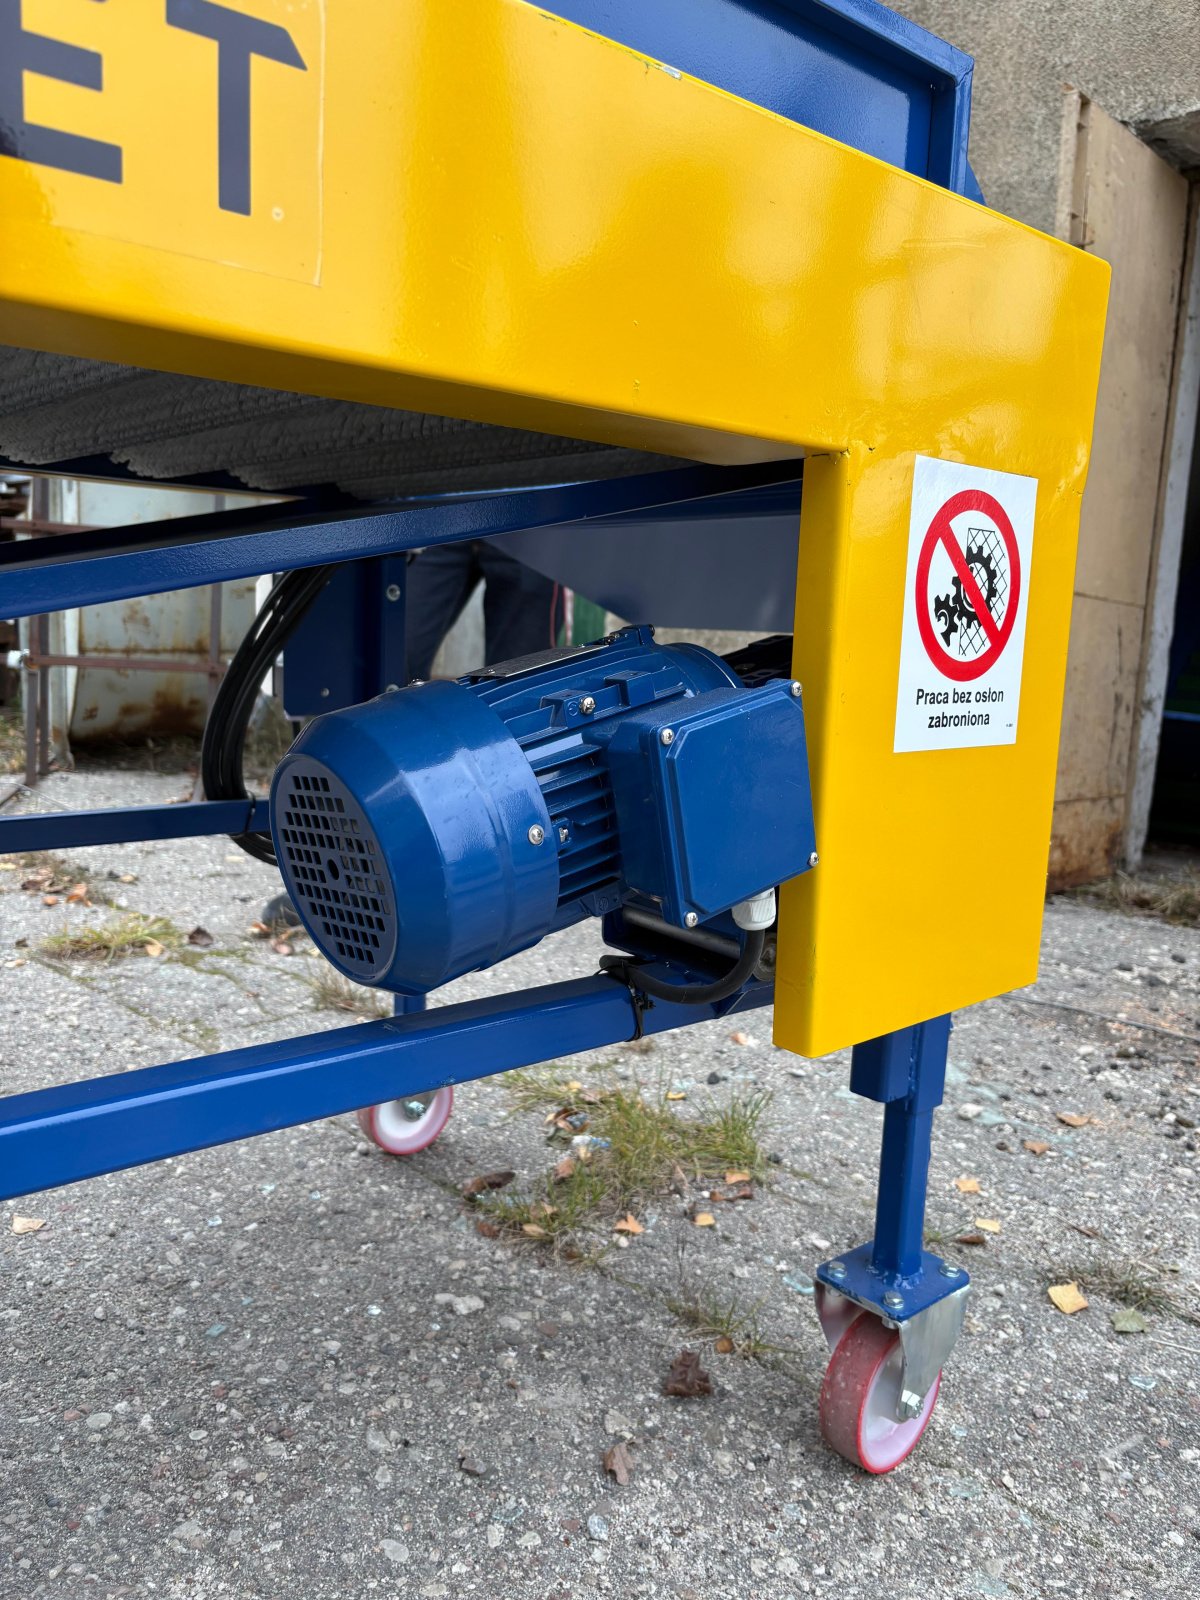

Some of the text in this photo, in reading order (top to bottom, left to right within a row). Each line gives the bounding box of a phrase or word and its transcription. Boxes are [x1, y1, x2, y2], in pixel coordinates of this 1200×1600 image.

[916, 687, 1004, 705] Praca bez osłon
[927, 710, 990, 728] zabroniona
